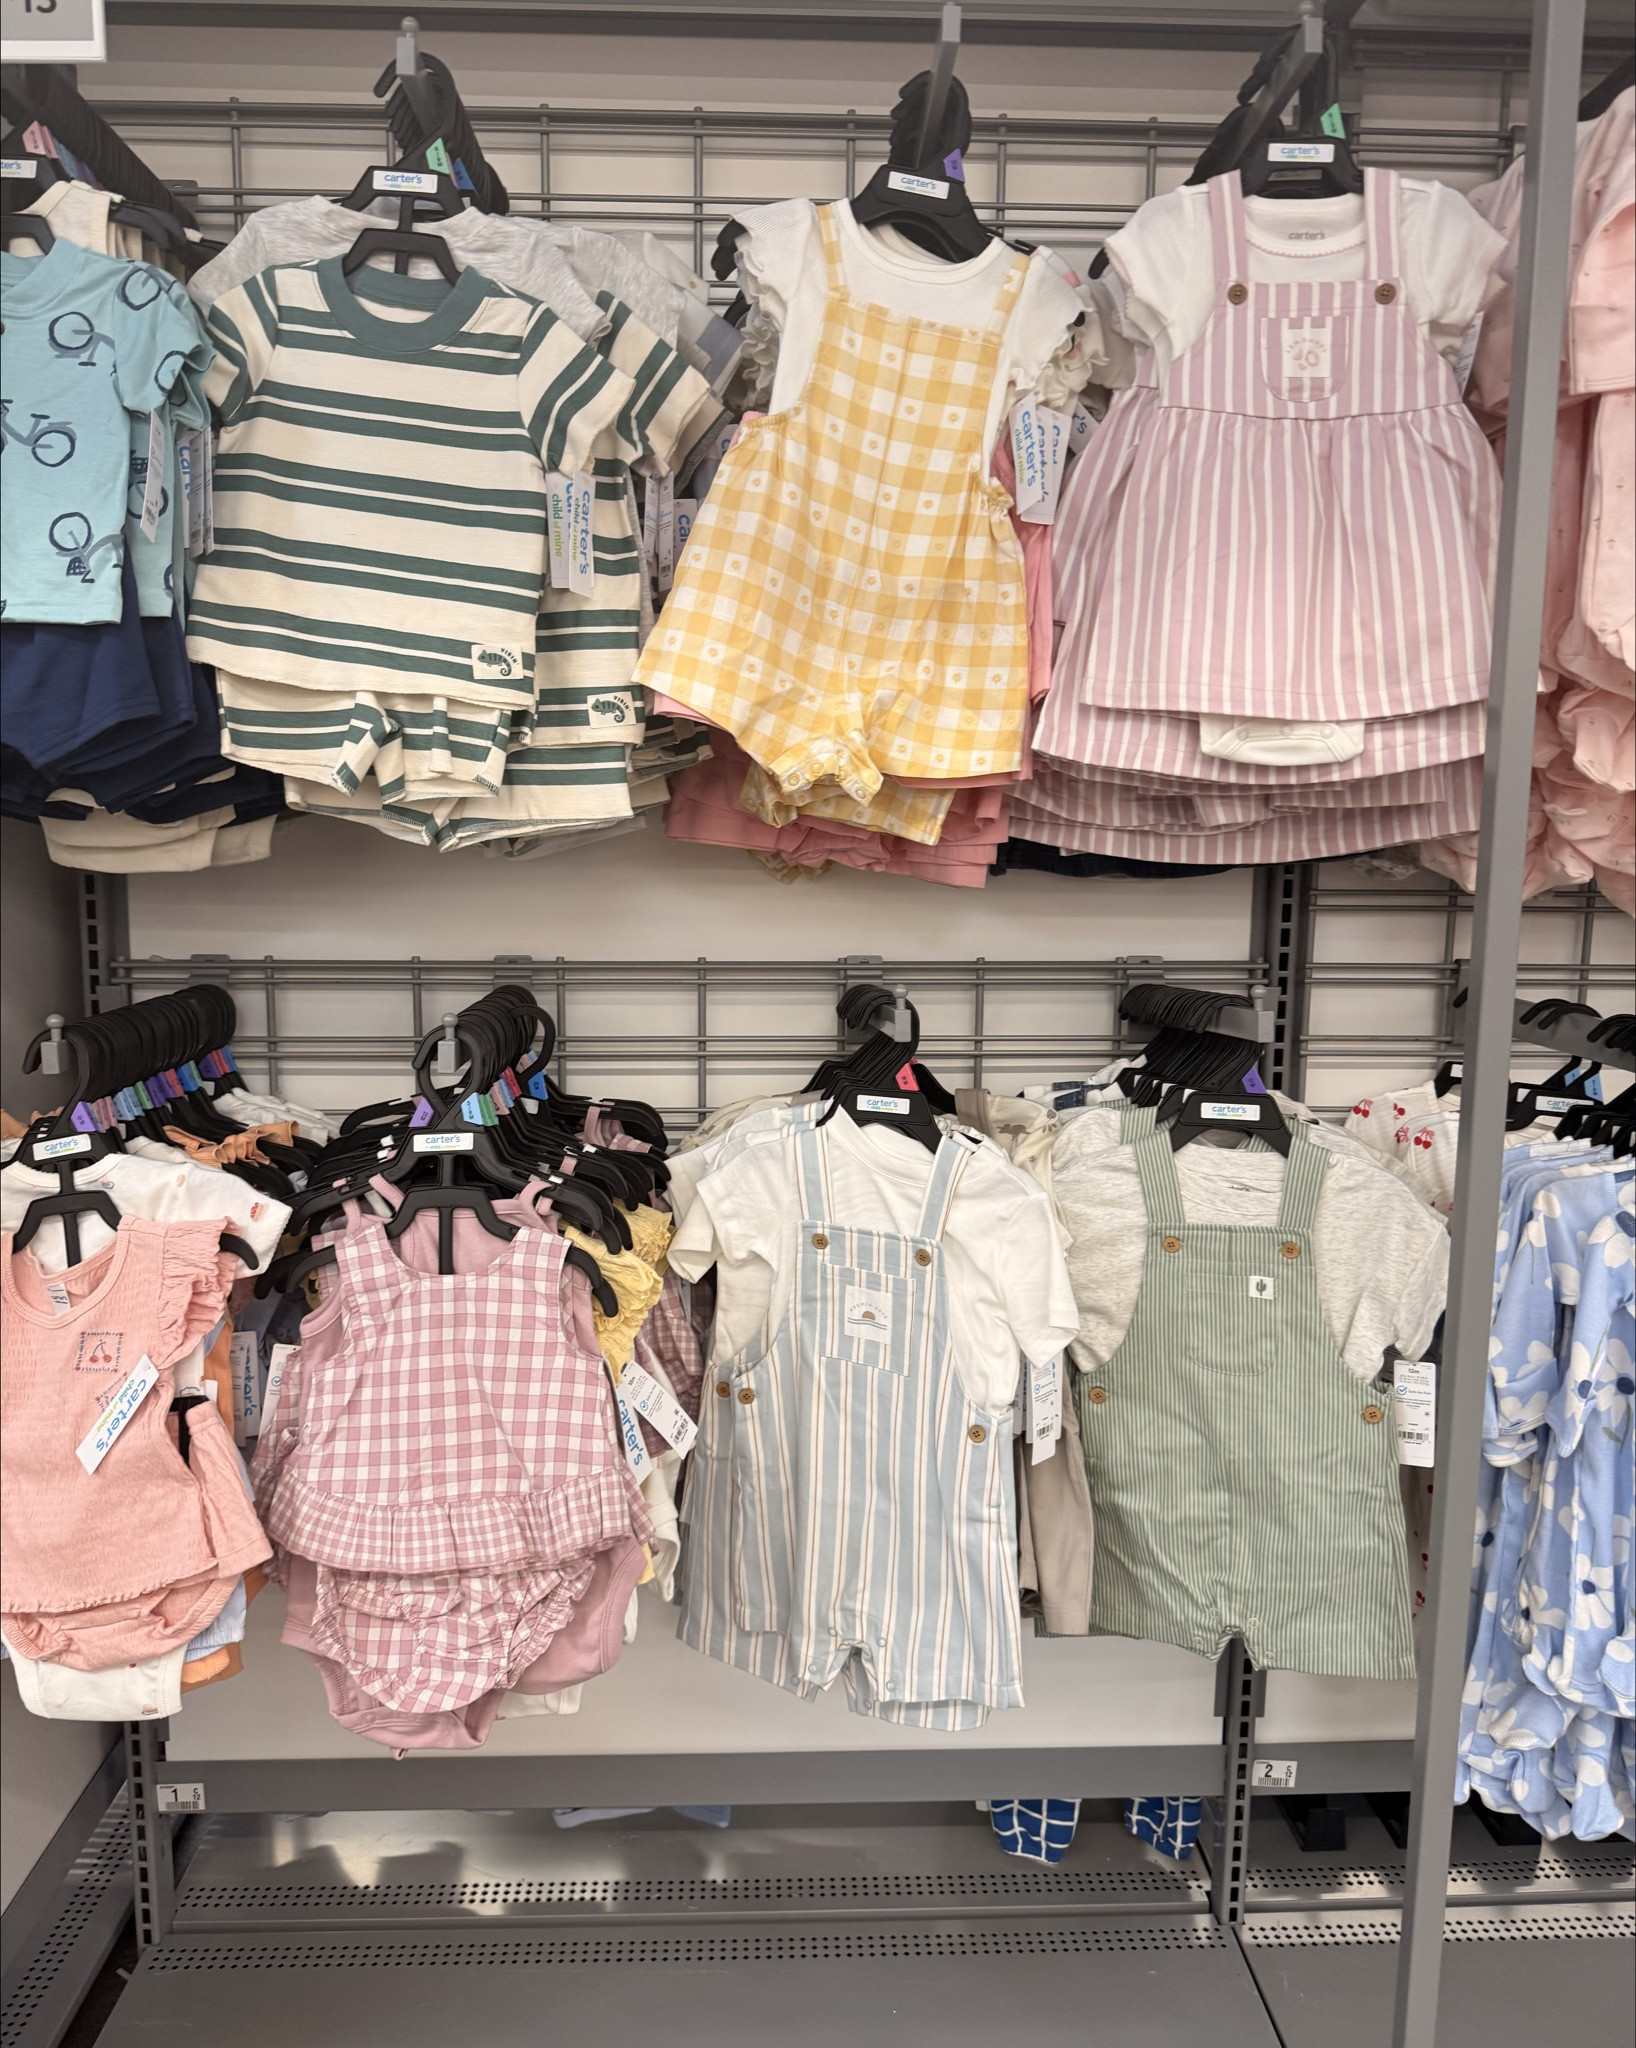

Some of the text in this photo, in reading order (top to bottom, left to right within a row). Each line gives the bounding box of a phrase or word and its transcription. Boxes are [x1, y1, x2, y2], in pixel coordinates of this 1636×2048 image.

[384, 174, 422, 184] carter's
[900, 177, 936, 190] carter's
[1022, 410, 1038, 487] carter's
[552, 493, 563, 520] child
[580, 490, 590, 575] carter's
[554, 530, 564, 557] mine
[866, 1099, 898, 1107] carter's
[1212, 1105, 1247, 1114] carter's
[44, 1138, 79, 1152] carter's
[425, 1135, 461, 1144] carter's
[118, 1379, 135, 1403] child
[96, 1379, 147, 1452] carter's
[96, 1409, 114, 1432] mine
[1264, 1763, 1273, 1778] 2
[171, 1787, 178, 1802] 1
